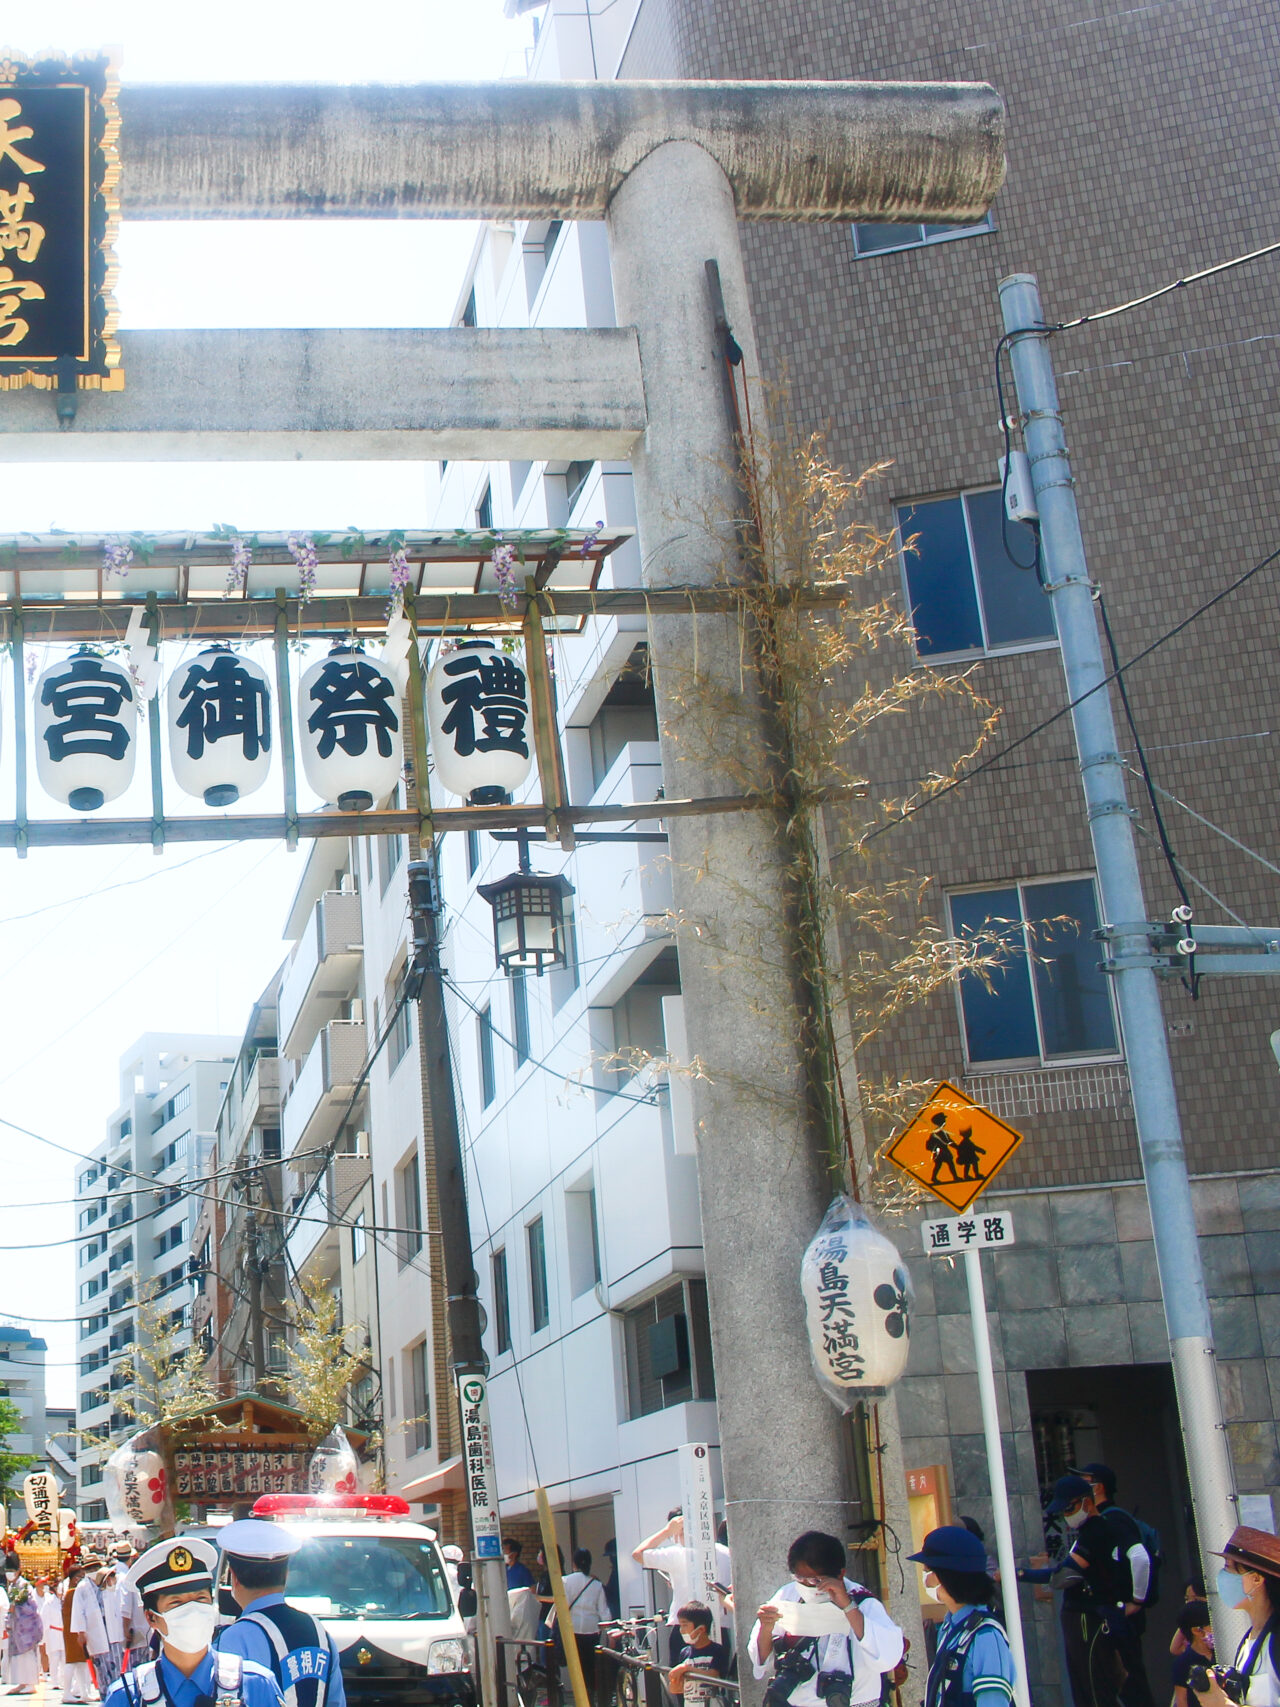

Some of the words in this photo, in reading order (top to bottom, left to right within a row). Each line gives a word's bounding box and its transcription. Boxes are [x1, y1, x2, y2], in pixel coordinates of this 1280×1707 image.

[929, 1217, 1005, 1248] 通学路
[815, 1236, 867, 1381] 湯島天満宮
[29, 1475, 52, 1522] 切通町会
[286, 1650, 328, 1681] 警視庁
